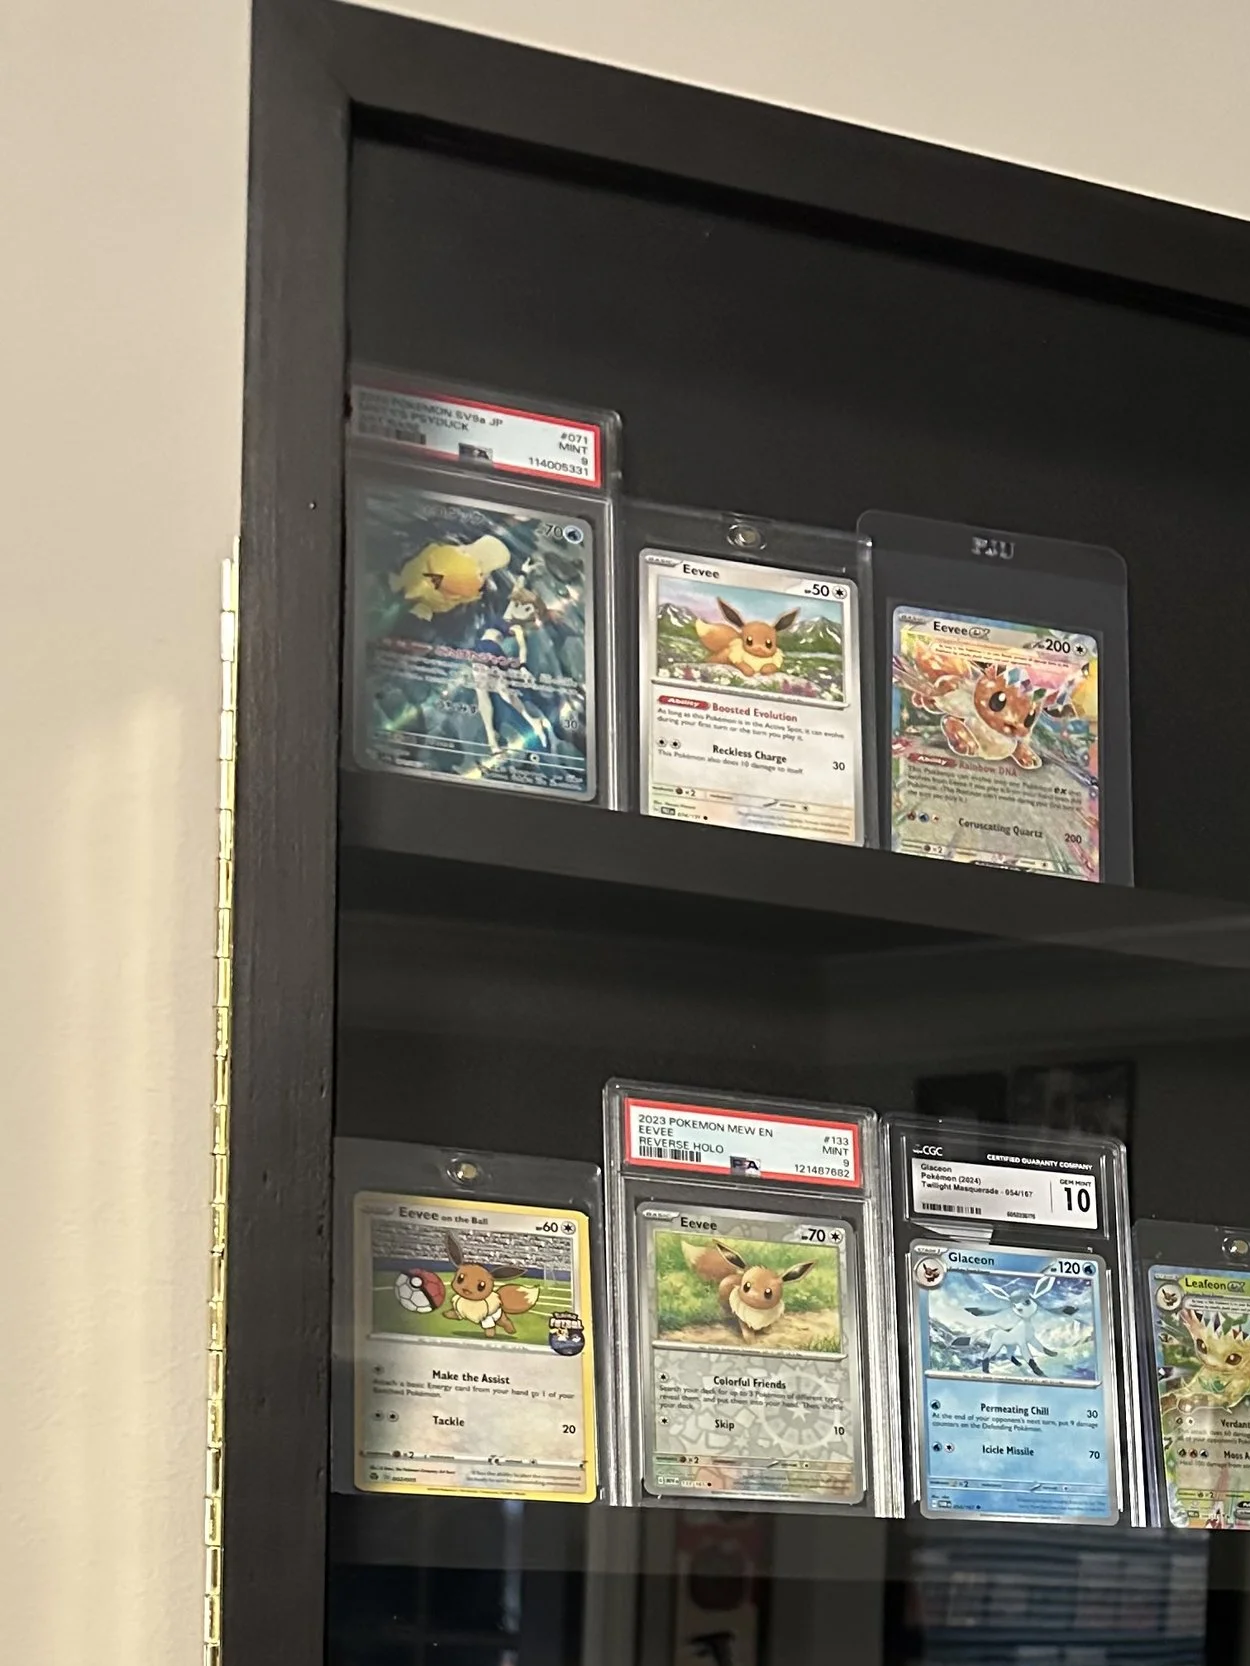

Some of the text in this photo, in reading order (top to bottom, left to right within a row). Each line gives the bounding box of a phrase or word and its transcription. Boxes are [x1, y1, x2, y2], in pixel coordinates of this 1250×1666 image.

[489, 416, 503, 427] JP
[560, 432, 588, 443] #071
[558, 442, 587, 454] MINT
[528, 457, 588, 476] 114005331
[683, 564, 720, 579] Eevee
[933, 621, 968, 636] Eevee
[713, 703, 750, 716] Boosted
[754, 709, 797, 722] Evolution
[713, 745, 752, 758] Reckless
[755, 747, 787, 763] Charge
[833, 762, 845, 770] 30
[999, 766, 1017, 777] DNA
[959, 818, 1043, 839] Coruscating Quartz
[1064, 833, 1082, 844] 200
[639, 1114, 773, 1137] 2023 POKEMON MEW EN
[639, 1125, 673, 1137] EEVEE
[640, 1137, 723, 1153] REVERSE HOLO
[822, 1146, 849, 1156] MINT
[987, 1154, 1092, 1170] CERTIFIED GUARANTY COMPANY
[1064, 1188, 1090, 1212] 10
[399, 1207, 439, 1221] Eevee
[455, 1216, 469, 1224] the
[472, 1217, 488, 1225] Ball
[681, 1217, 717, 1230] Eevee
[949, 1252, 994, 1266] Glaceon
[1185, 1278, 1226, 1290] Leafeon
[433, 1370, 510, 1384] Make the Assist
[714, 1376, 786, 1389] Colorful Friends
[981, 1403, 1049, 1416] Permeating Chill
[1087, 1410, 1098, 1418] 30
[433, 1416, 464, 1426] Tackle
[715, 1420, 735, 1431] Skip
[1221, 1419, 1250, 1429] Verdant
[563, 1425, 575, 1433] 20
[834, 1426, 844, 1435] 10
[982, 1445, 1034, 1456] Icicle Missile
[1089, 1451, 1100, 1459] 70
[1224, 1451, 1243, 1460] Moss
